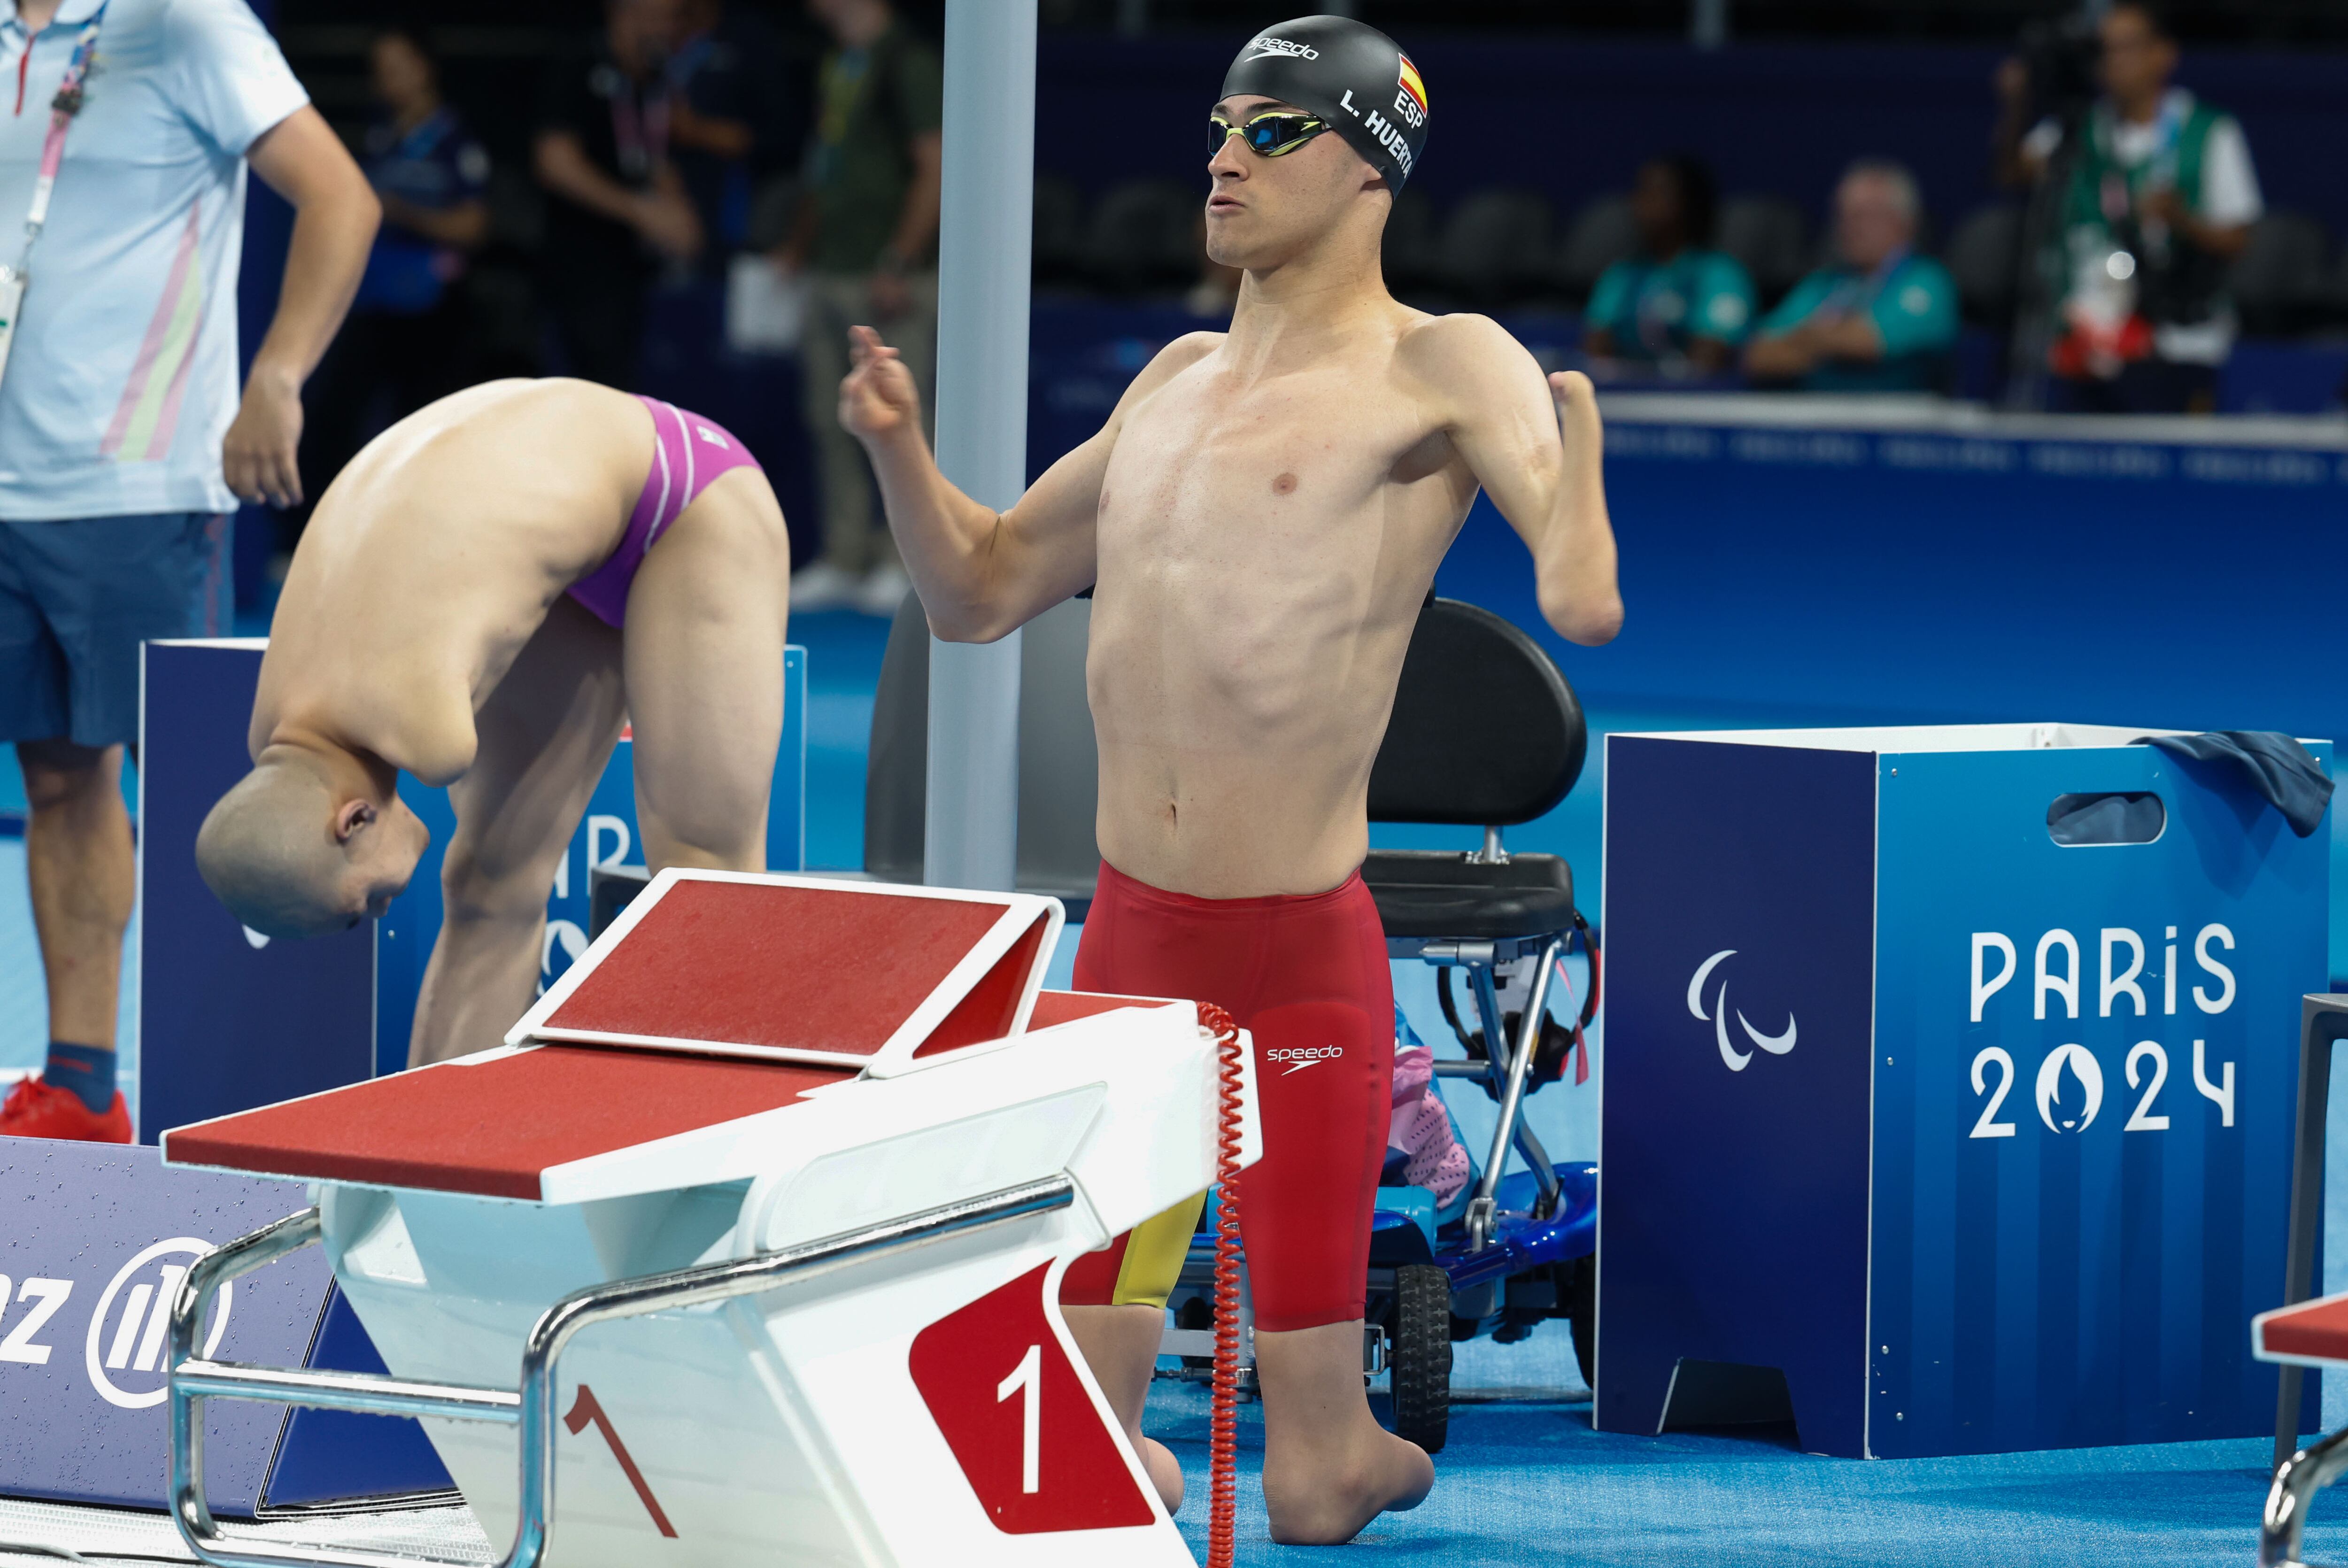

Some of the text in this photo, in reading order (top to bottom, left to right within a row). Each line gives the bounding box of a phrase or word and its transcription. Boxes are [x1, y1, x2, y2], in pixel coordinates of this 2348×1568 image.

[1248, 38, 1319, 60] speedo
[1340, 89, 1413, 179] L. HUERTA
[1394, 90, 1423, 129] ESP
[1267, 1045, 1343, 1062] speedo
[1969, 1039, 2235, 1138] 2024
[563, 1383, 680, 1538] 1
[997, 1344, 1041, 1494] 1
